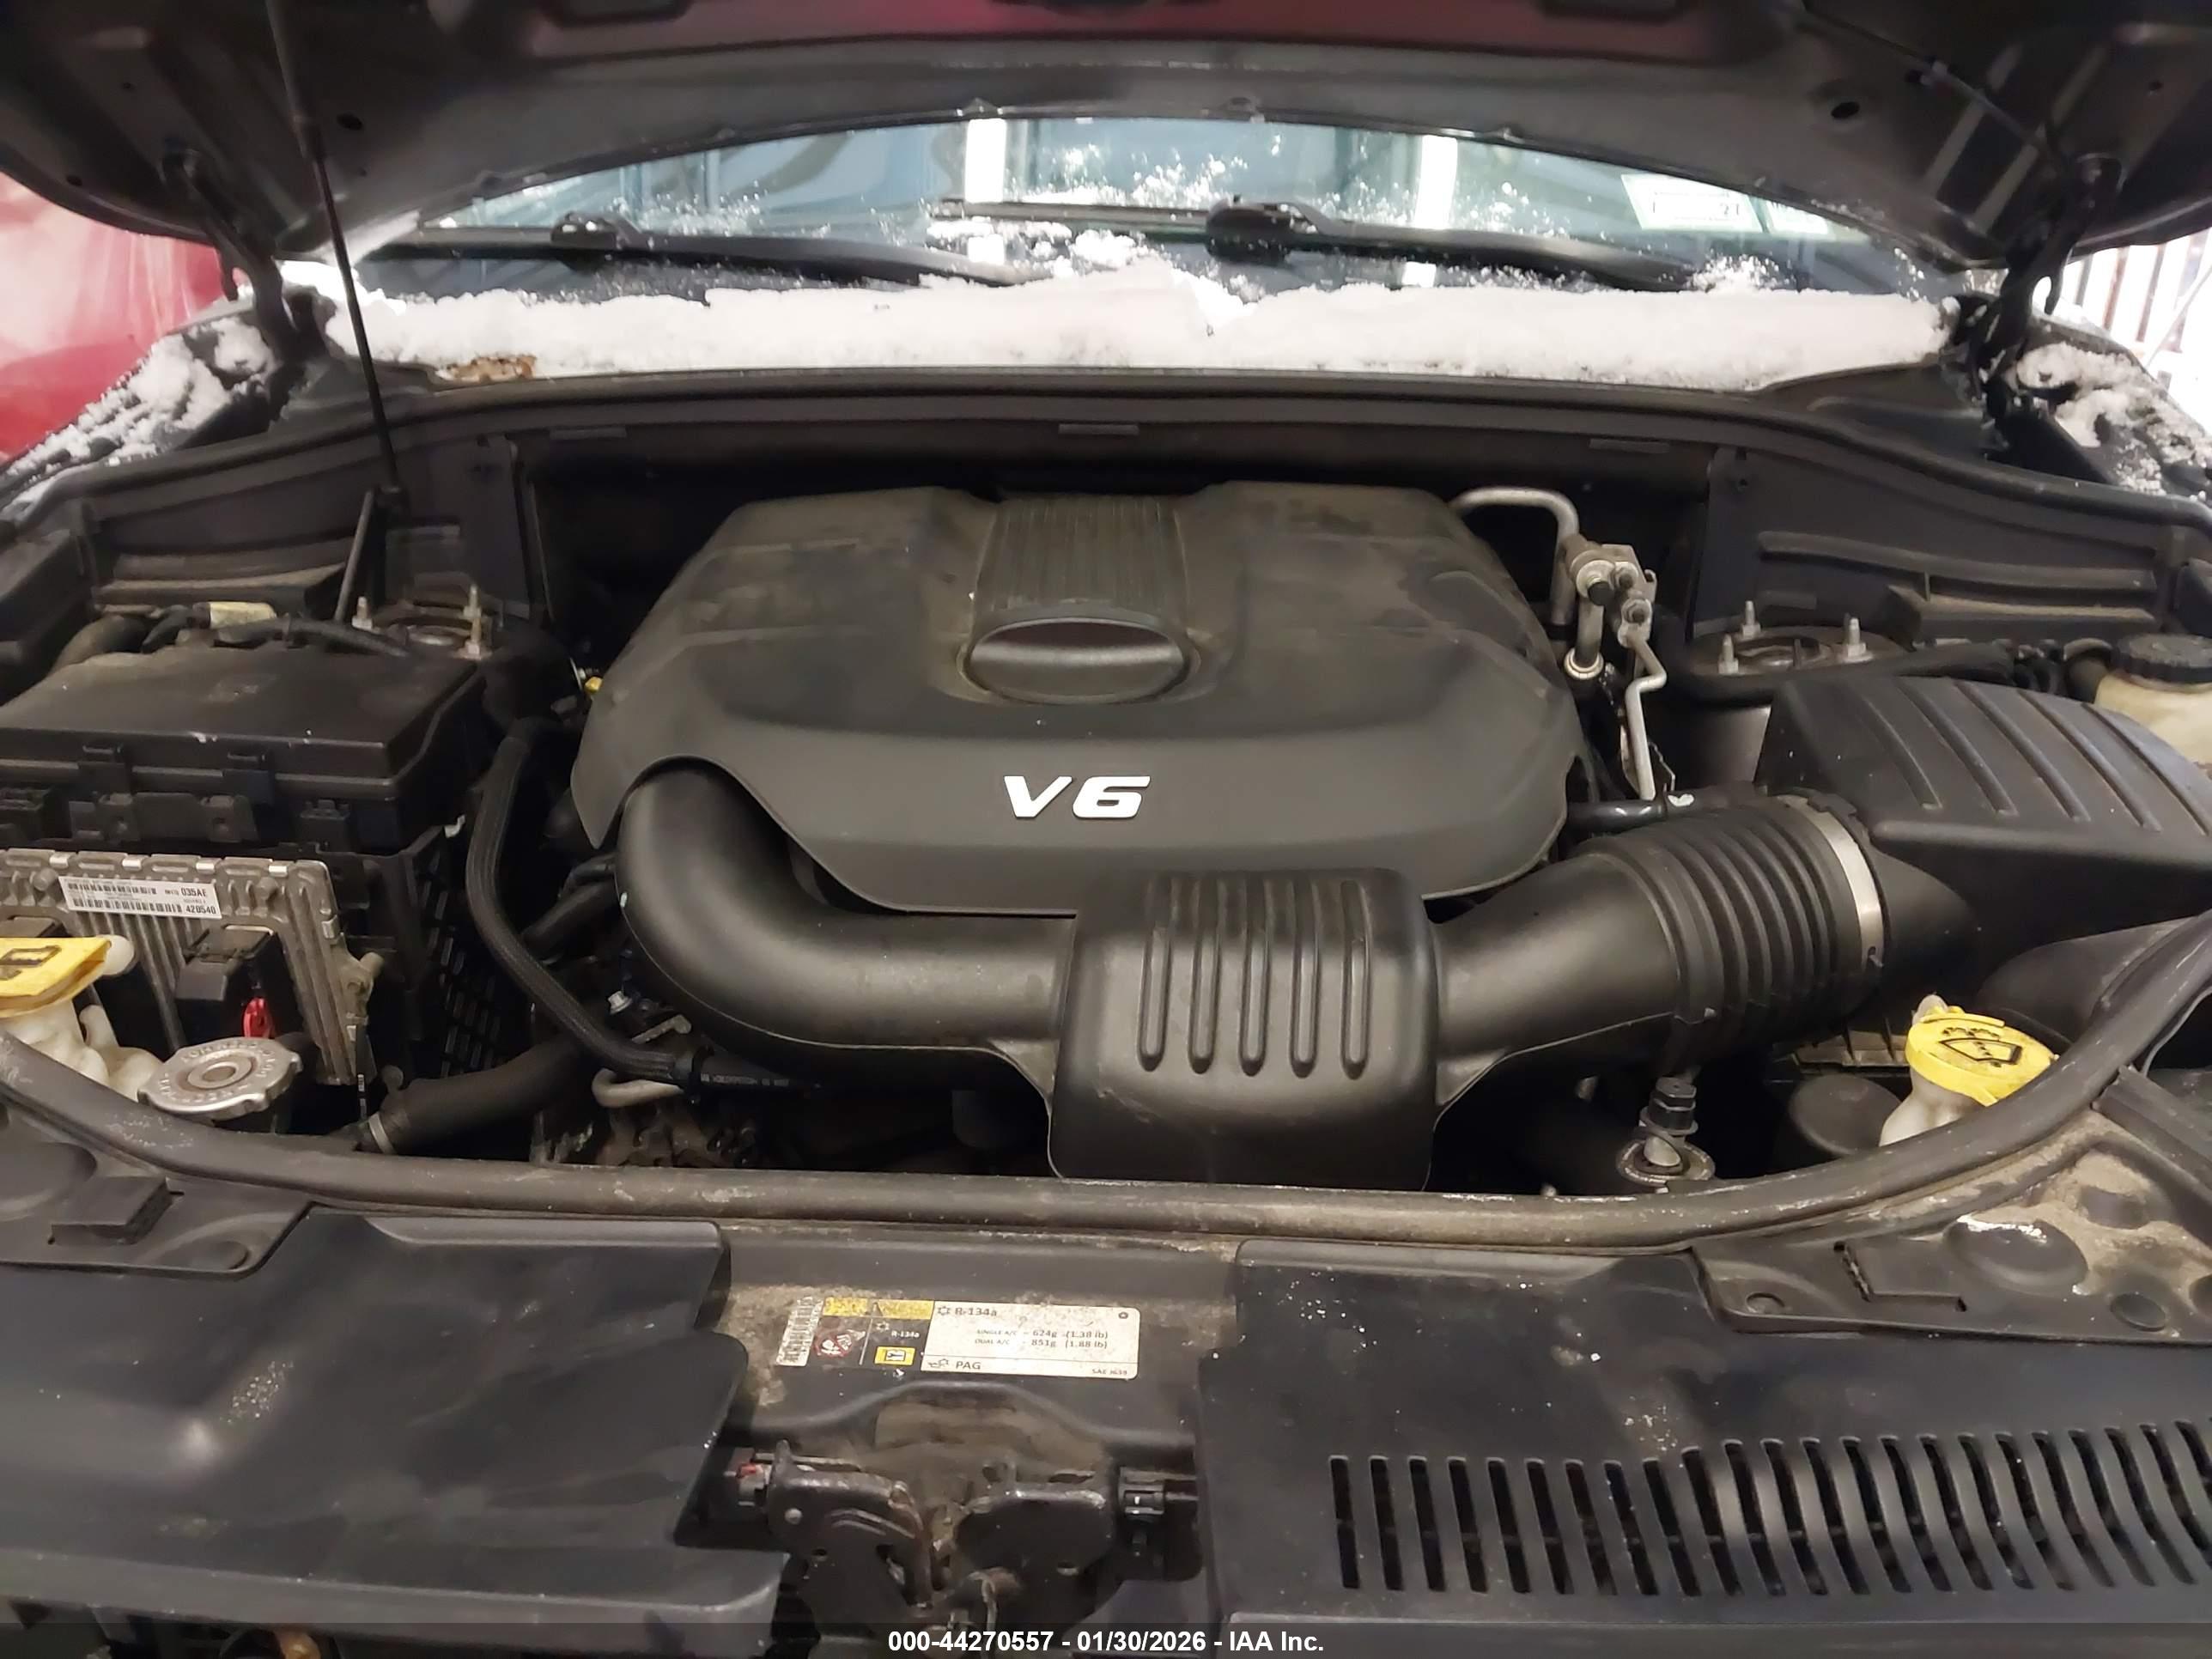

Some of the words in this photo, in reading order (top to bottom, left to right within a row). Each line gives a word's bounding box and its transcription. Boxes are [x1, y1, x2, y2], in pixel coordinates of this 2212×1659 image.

[1003, 775, 1152, 819] V6
[954, 1307, 998, 1317] R-134a
[1032, 1329, 1058, 1339] 624g
[955, 1360, 981, 1370] PAG
